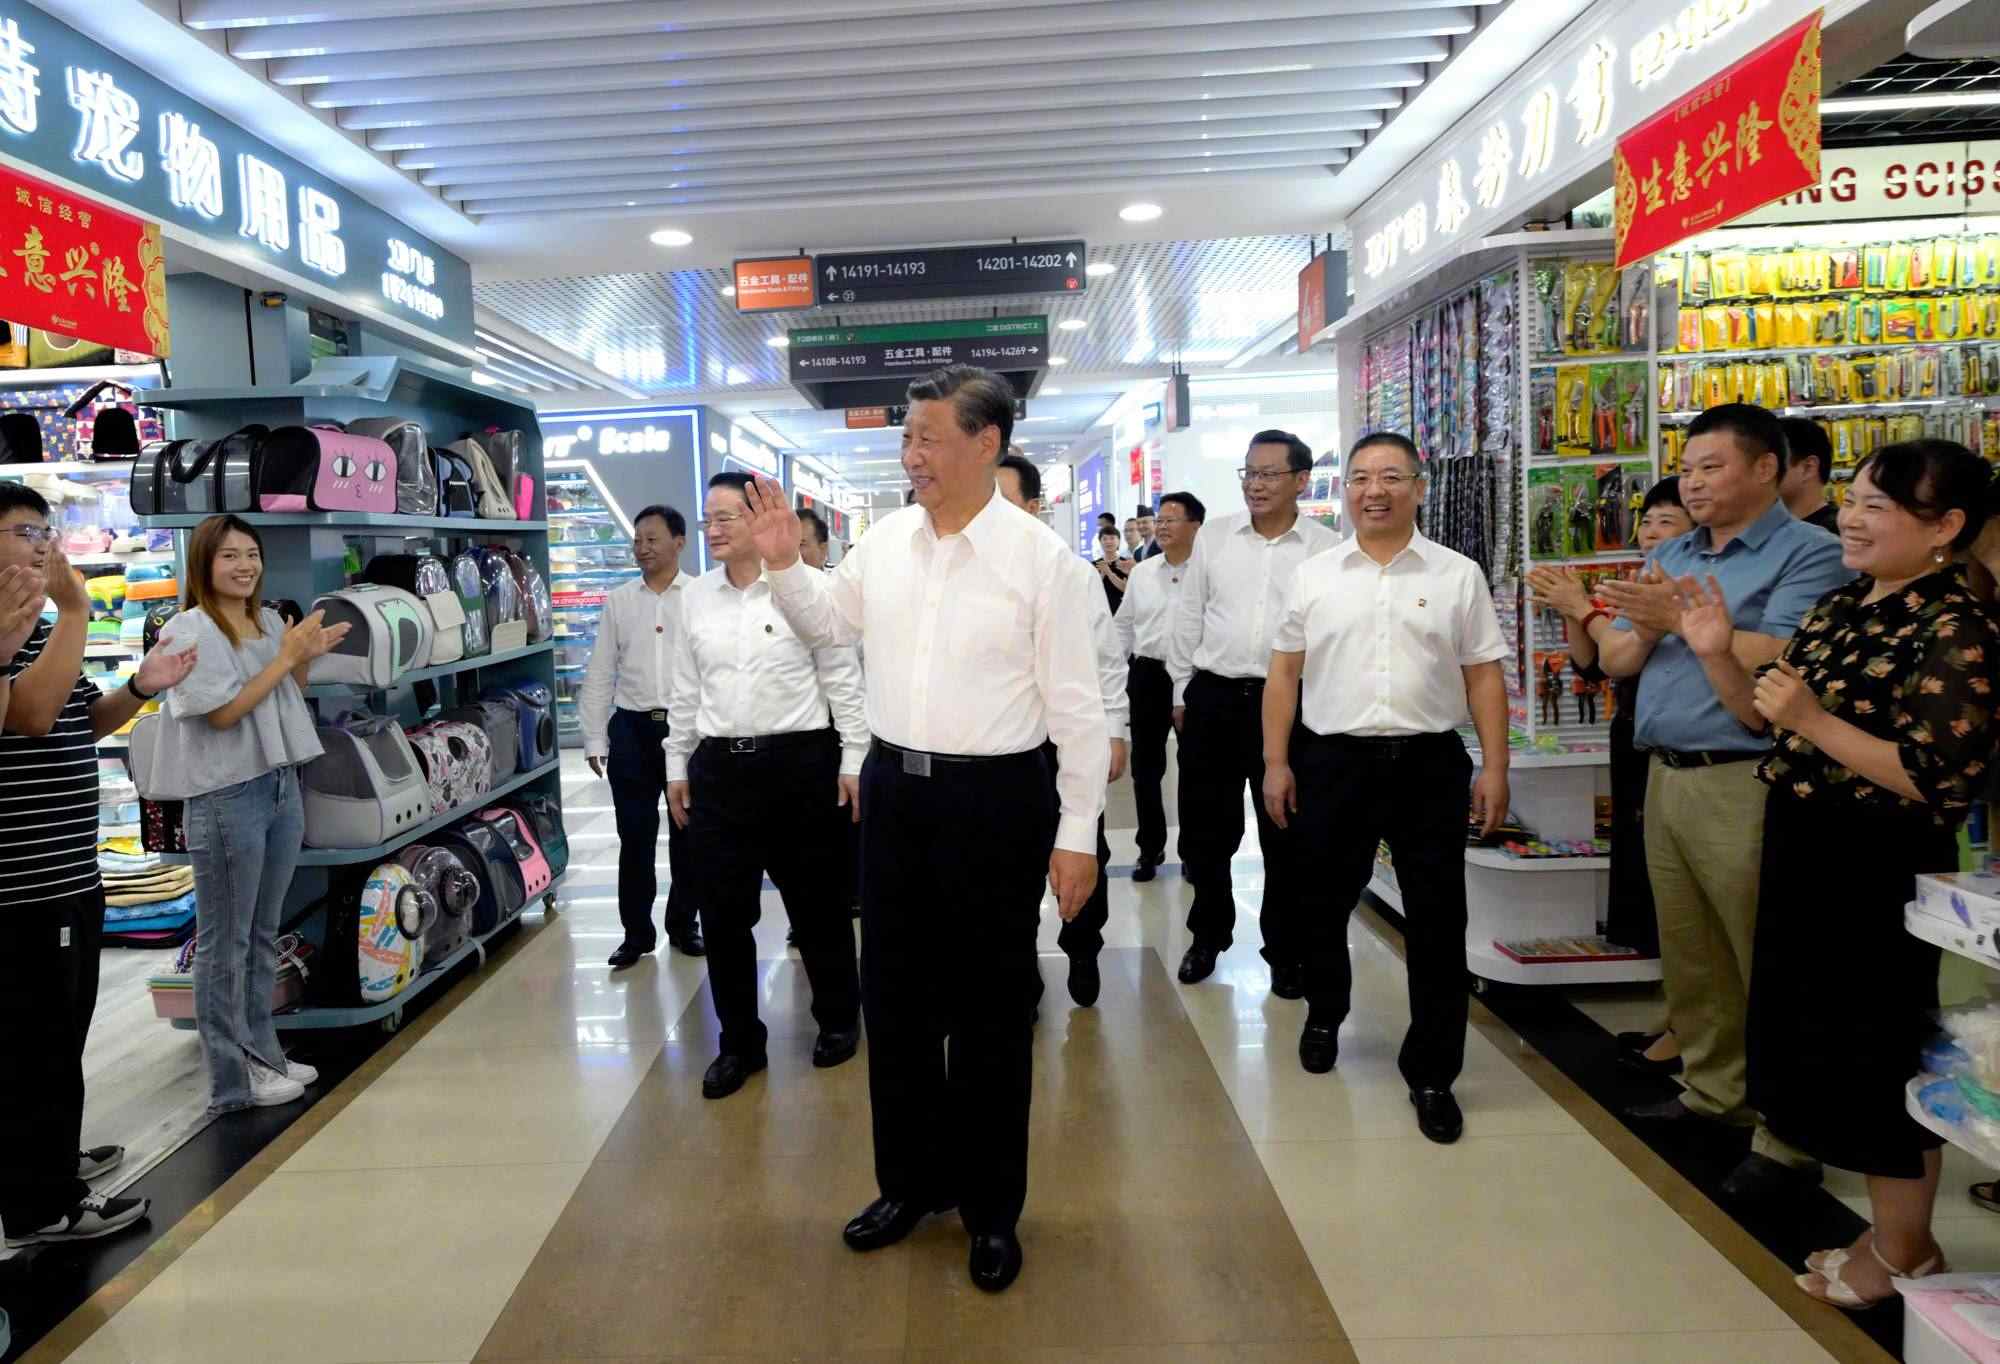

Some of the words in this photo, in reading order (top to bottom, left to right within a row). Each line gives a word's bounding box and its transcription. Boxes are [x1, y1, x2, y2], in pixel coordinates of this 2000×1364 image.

[1641, 100, 1773, 216] 生意兴隆
[15, 187, 92, 230] 诚信经营
[0, 225, 140, 313] 意兴隆
[840, 261, 926, 280] 14191-14193
[976, 254, 1063, 271] 14201-14202
